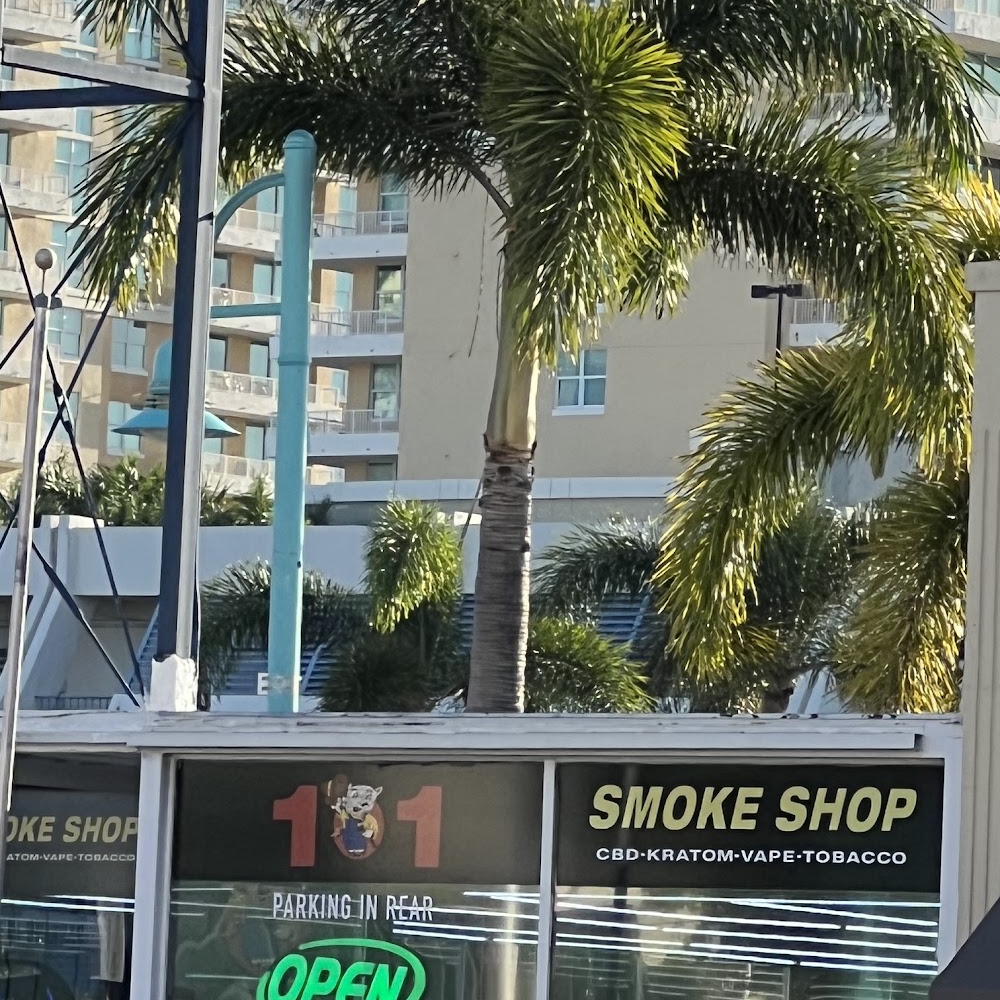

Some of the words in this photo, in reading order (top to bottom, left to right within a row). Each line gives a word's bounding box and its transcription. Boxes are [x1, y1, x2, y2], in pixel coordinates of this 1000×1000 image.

[589, 784, 764, 830] SMOKE
[775, 786, 917, 833] SHOP
[62, 815, 138, 843] SHOP
[272, 892, 350, 920] PARKING
[360, 894, 377, 921] IN
[386, 895, 433, 921] REAR
[268, 953, 408, 1000] OPEN
